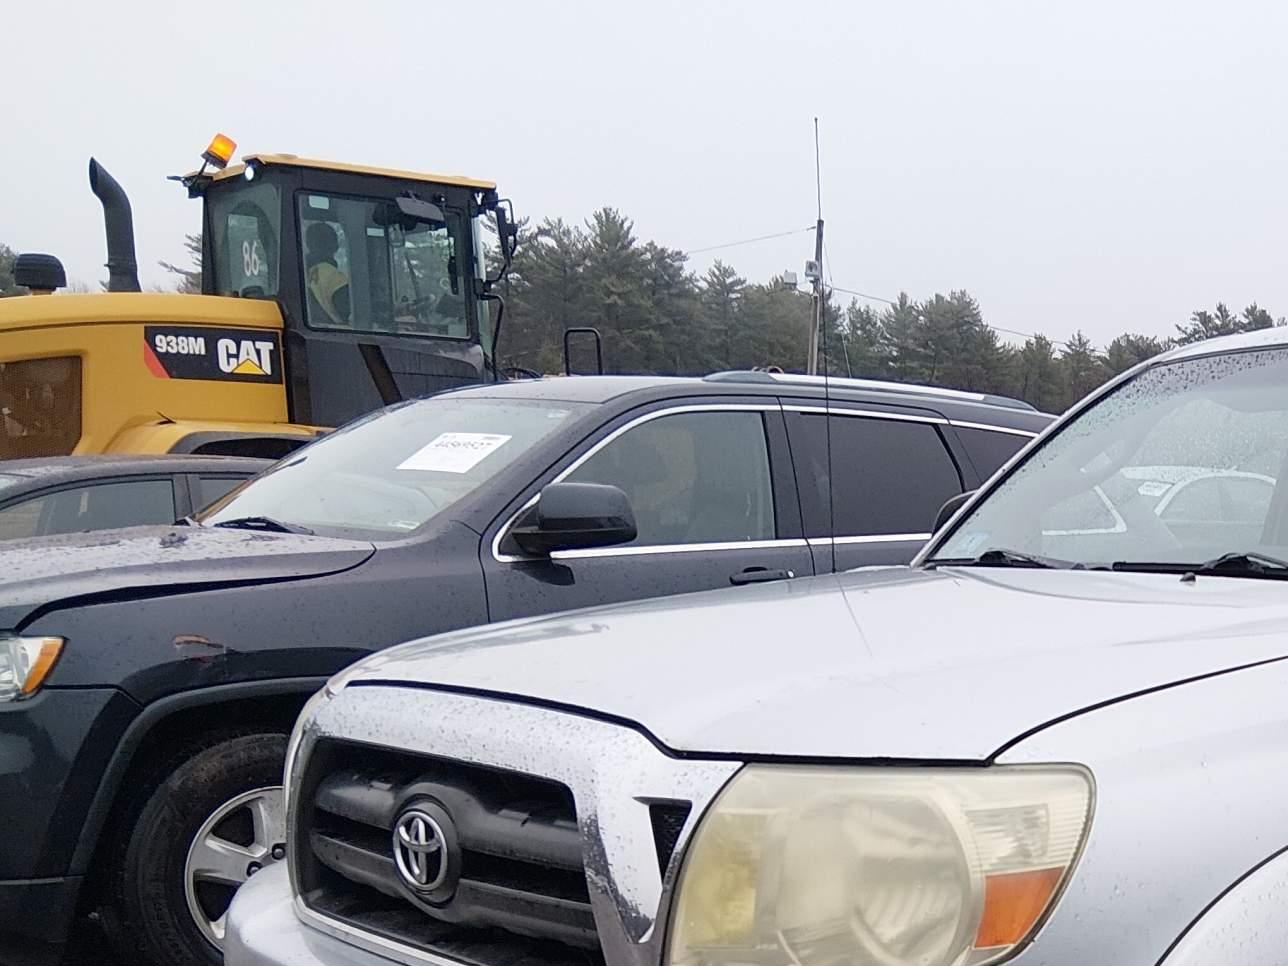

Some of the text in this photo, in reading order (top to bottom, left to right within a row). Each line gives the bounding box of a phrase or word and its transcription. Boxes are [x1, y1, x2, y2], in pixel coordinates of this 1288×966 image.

[242, 240, 260, 277] 86
[154, 334, 207, 355] 938M
[217, 338, 275, 376] CAT
